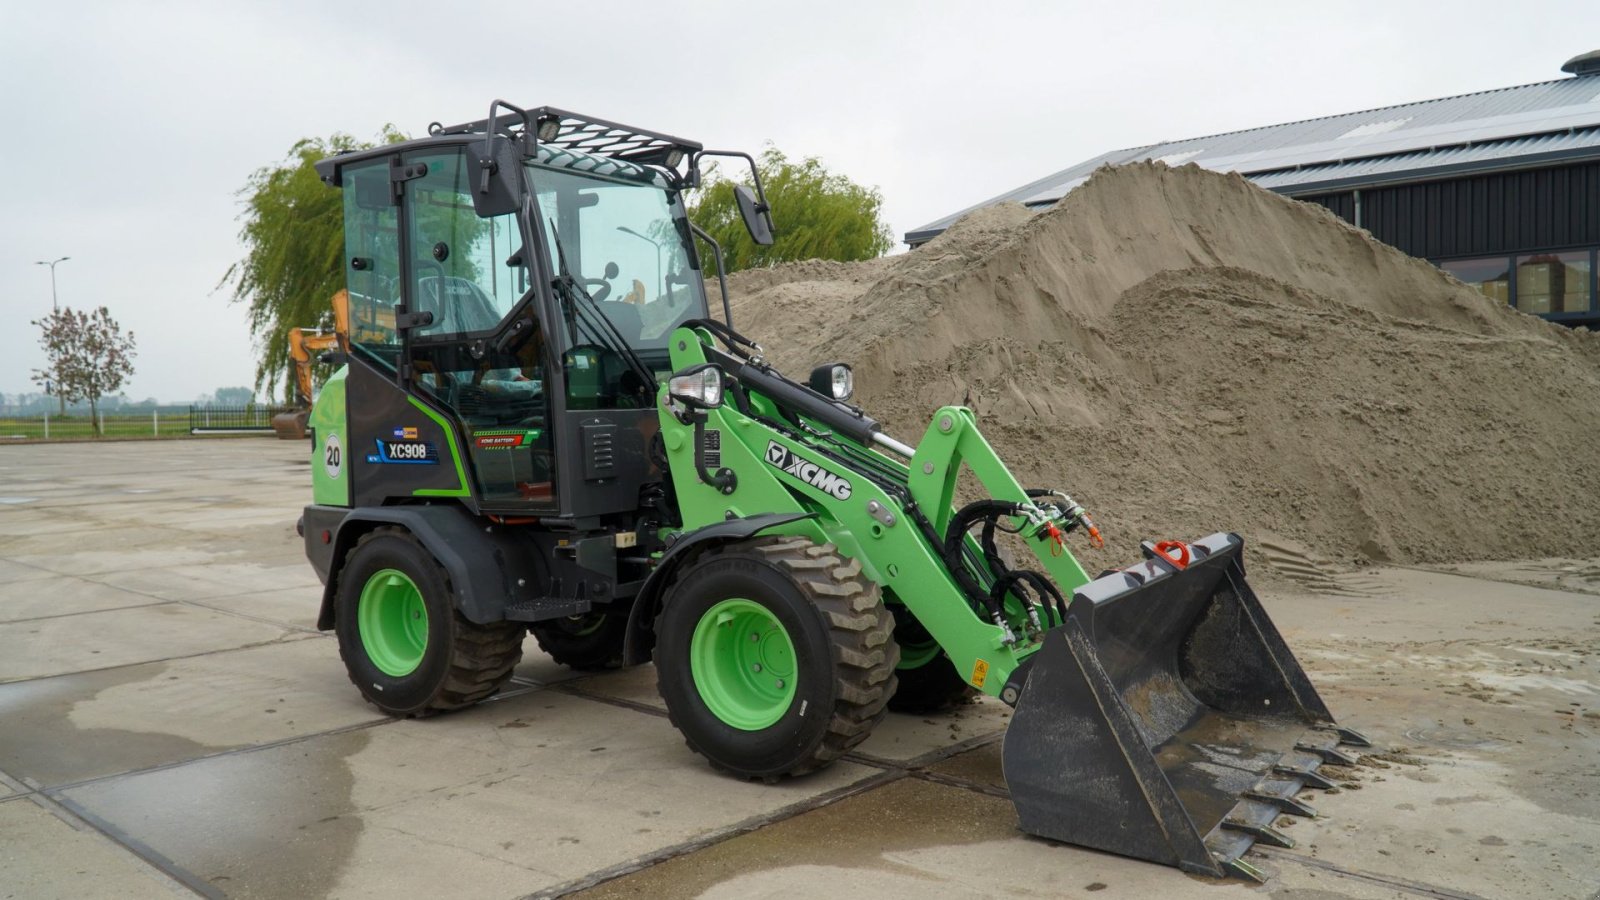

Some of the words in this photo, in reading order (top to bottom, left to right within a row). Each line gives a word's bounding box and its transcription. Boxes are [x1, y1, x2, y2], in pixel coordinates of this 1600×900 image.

[327, 445, 340, 467] 20
[389, 443, 426, 459] XC908
[783, 453, 852, 501] XCMG
